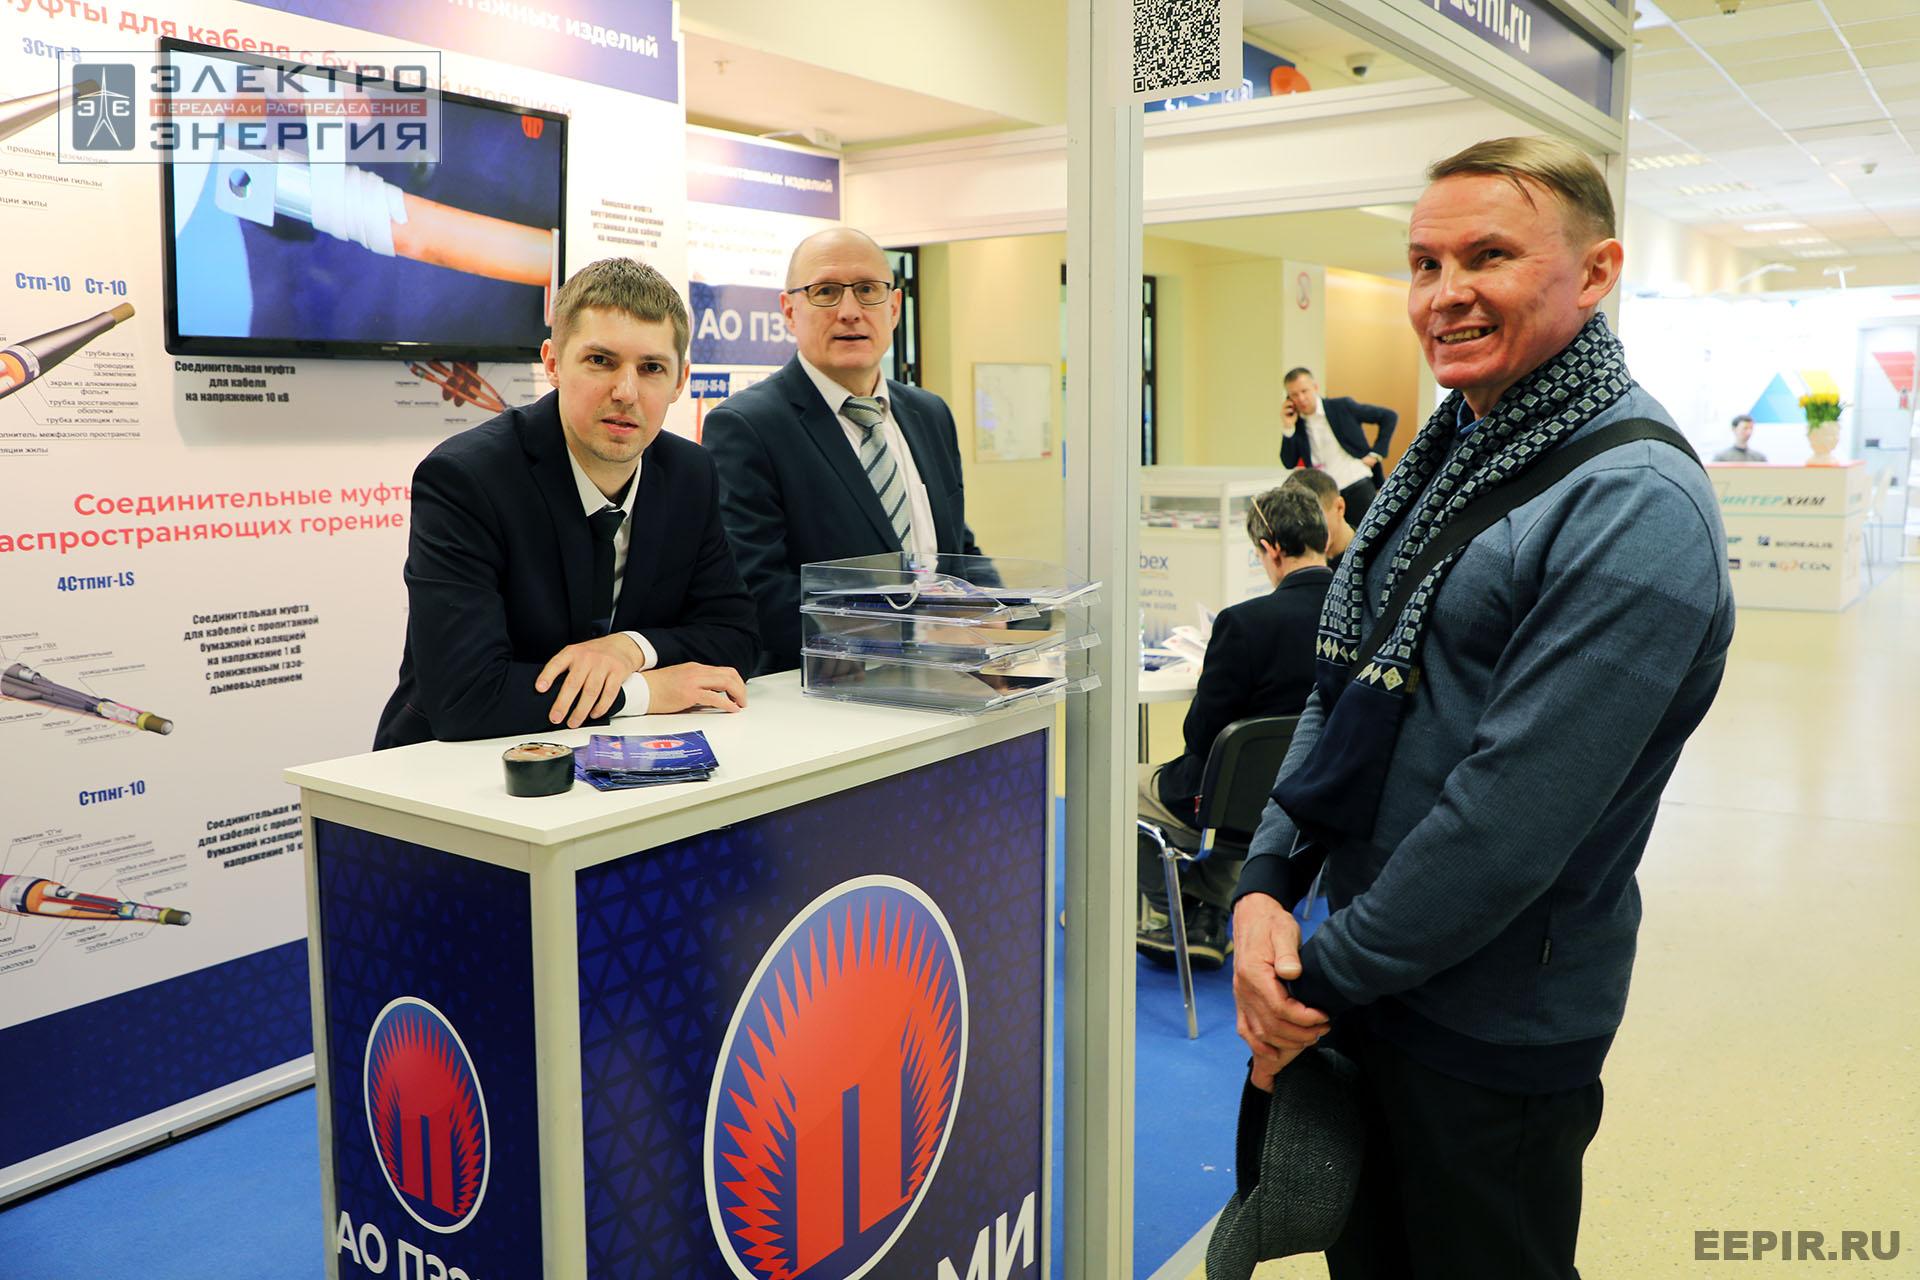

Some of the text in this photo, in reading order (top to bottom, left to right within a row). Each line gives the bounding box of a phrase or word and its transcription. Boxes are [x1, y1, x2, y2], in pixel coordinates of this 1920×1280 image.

[7, 0, 108, 24] уфты
[119, 11, 177, 37] для
[188, 25, 290, 56] кабеля
[566, 17, 659, 58] изделий
[7, 144, 56, 158] проводник
[15, 272, 127, 296] Стп-10 Ст-10
[697, 308, 743, 341] АО
[175, 360, 296, 376] Соединительная муфта
[209, 377, 267, 389] для кабеля
[185, 392, 290, 403] на напряжение 10 кВ
[74, 488, 333, 516] Соединительные
[300, 512, 404, 536] горение
[57, 571, 136, 592] 4Стпнг-LS
[193, 604, 310, 625] Соединительная муфта
[184, 615, 319, 642] для кабелей с пропитанной
[200, 631, 307, 653] бумажной изоляцией
[207, 656, 219, 666] на
[221, 648, 282, 665] напряжение
[290, 645, 302, 655] кВ
[205, 671, 211, 680] с
[213, 661, 280, 680] пониженным
[210, 672, 303, 695] дымовыделением
[79, 779, 146, 807] Стпнг-10
[206, 804, 289, 831] Соединительная
[198, 835, 218, 848] для
[219, 825, 261, 842] кабелей
[262, 823, 268, 832] с
[206, 840, 258, 859] бумажной
[223, 847, 284, 869] напряжение
[286, 842, 295, 853] 10
[337, 1210, 480, 1280] АО ПЗ
